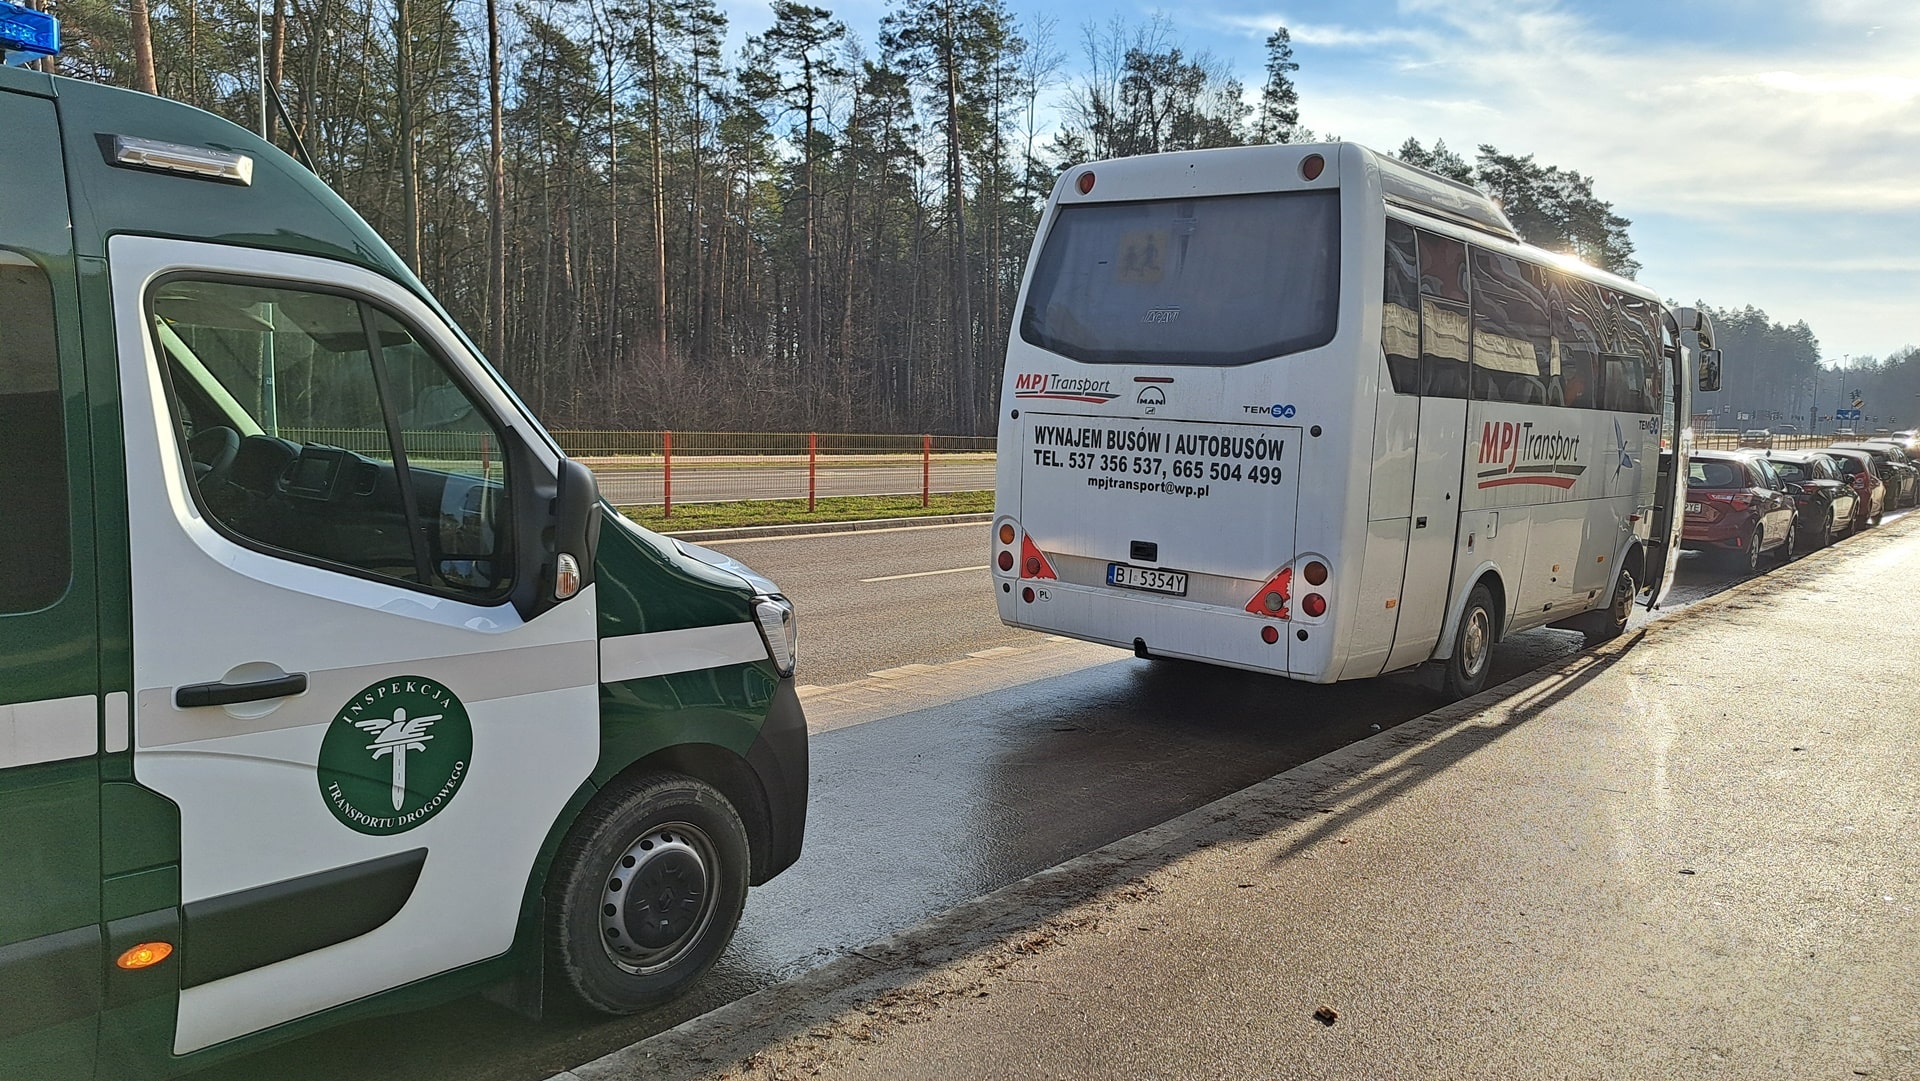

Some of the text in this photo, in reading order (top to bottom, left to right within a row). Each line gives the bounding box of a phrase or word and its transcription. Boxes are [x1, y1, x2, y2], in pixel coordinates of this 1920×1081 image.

[1015, 374, 1110, 395] MPJ Transport
[1243, 404, 1296, 418] TEMSA
[1034, 425, 1285, 461] WYNAJEM BUSÓW I AUTOBUSÓW
[1478, 421, 1580, 473] MPJ Transport
[1033, 449, 1282, 485] TEL. 537 356 537, 665 504 499
[1087, 476, 1209, 498] mpjtransport@wp.pl
[1115, 568, 1184, 591] BI 5354Y
[1039, 590, 1049, 599] PL
[342, 681, 451, 724] INSPEKCJA
[327, 760, 464, 828] TRANSPORTU DROGOWEGO
